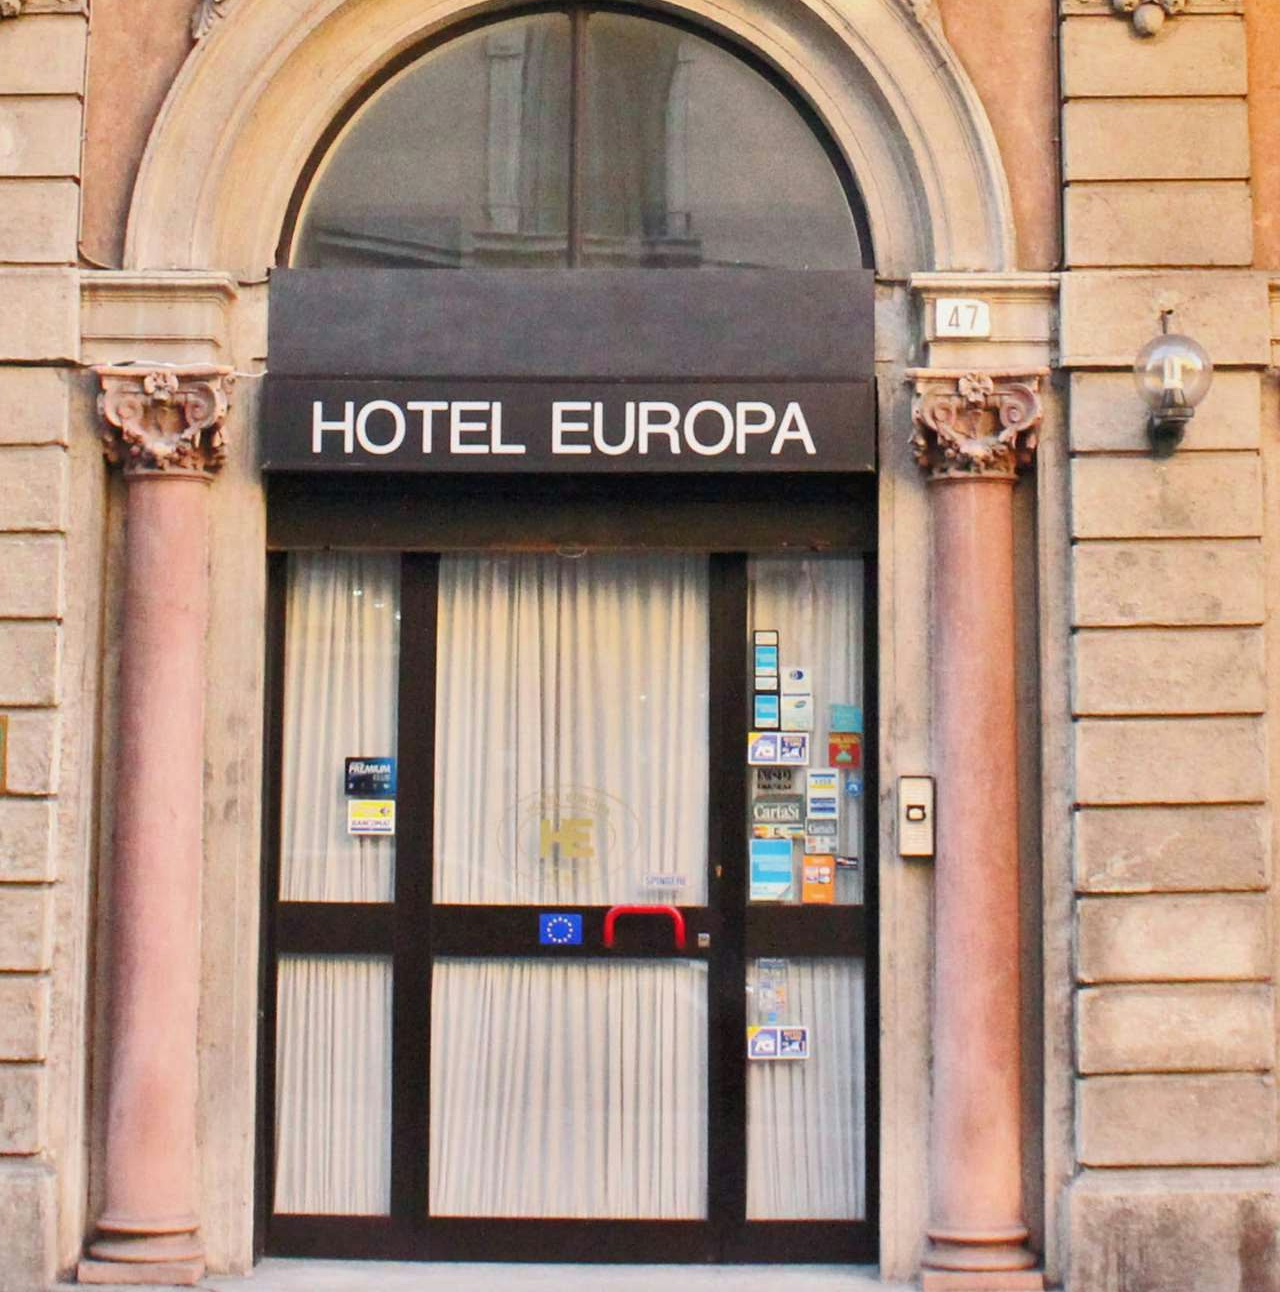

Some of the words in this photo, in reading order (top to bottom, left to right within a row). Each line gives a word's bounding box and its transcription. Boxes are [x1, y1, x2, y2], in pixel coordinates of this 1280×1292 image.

[948, 304, 979, 330] 47
[312, 399, 527, 455] HOTEL
[551, 400, 817, 456] EUROPA
